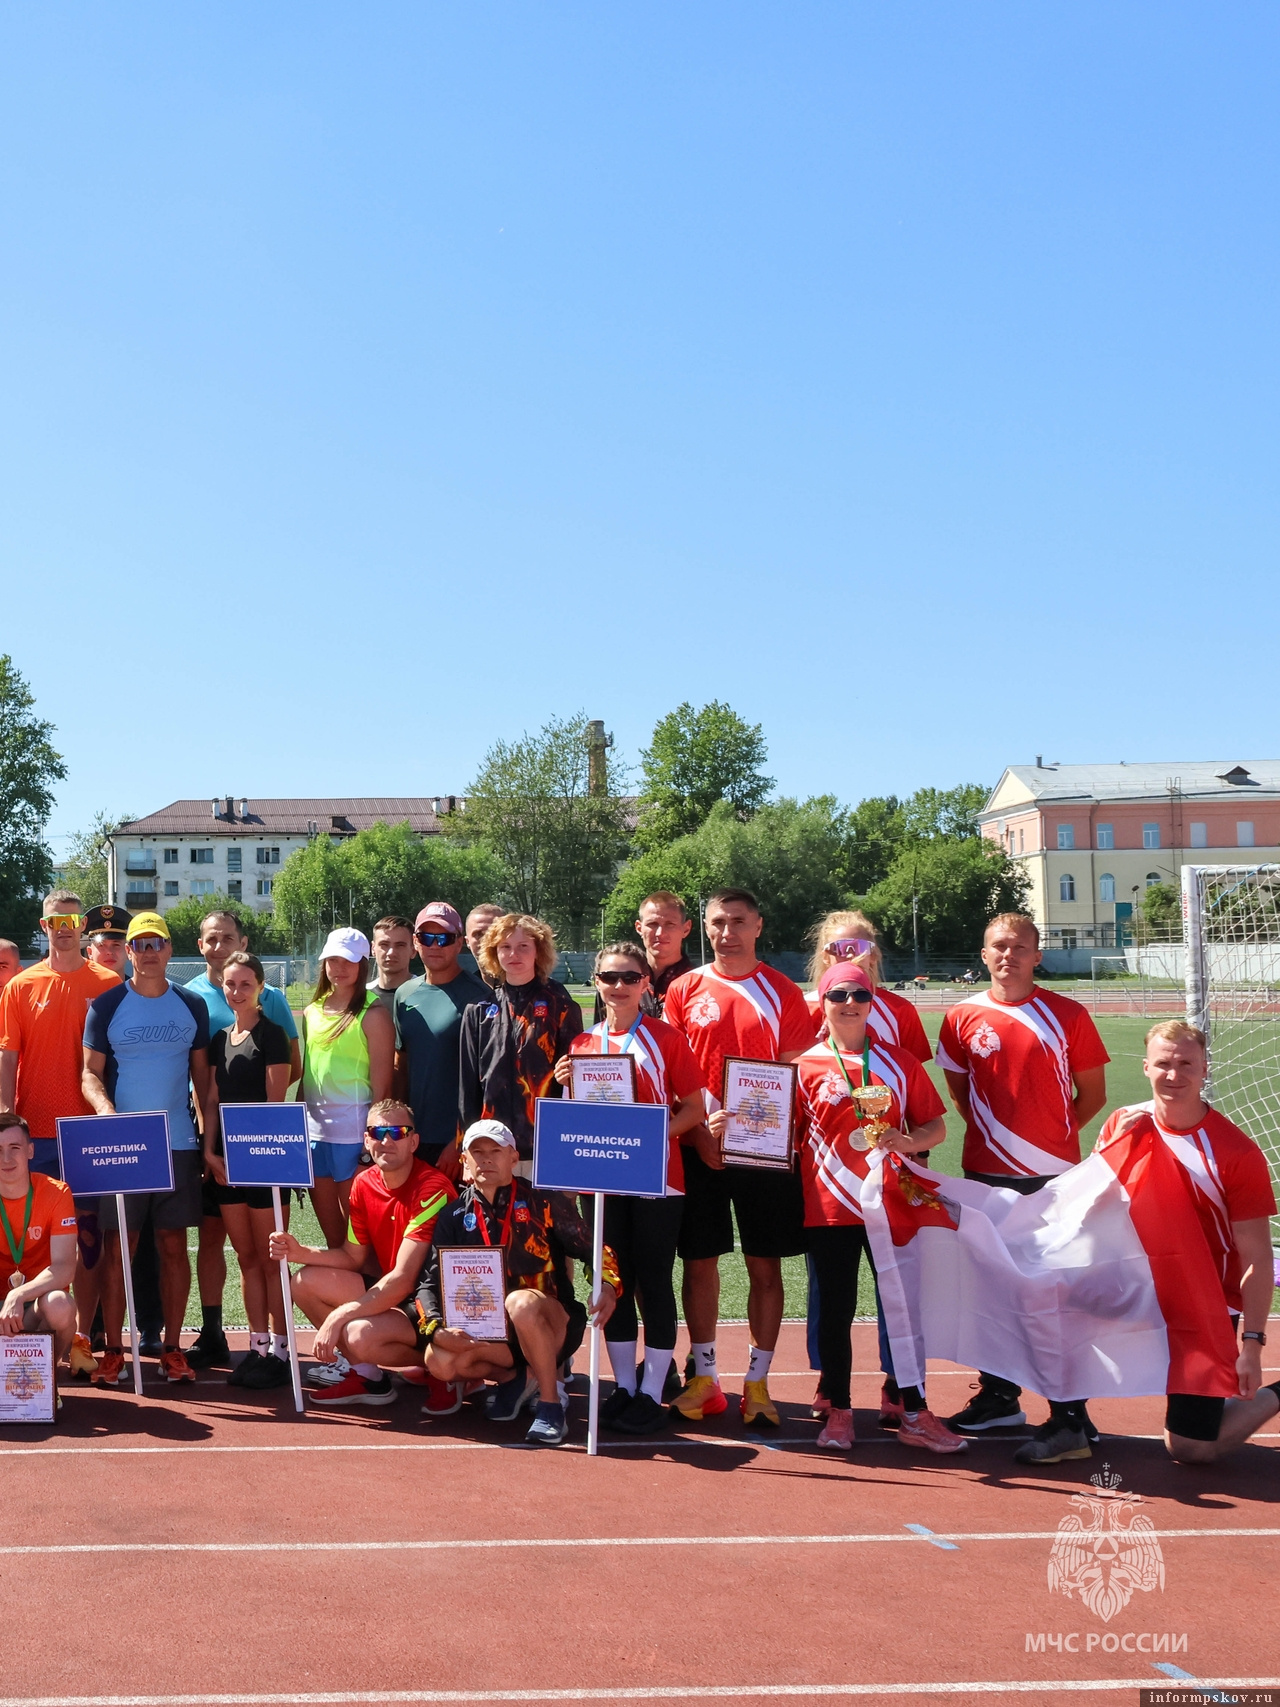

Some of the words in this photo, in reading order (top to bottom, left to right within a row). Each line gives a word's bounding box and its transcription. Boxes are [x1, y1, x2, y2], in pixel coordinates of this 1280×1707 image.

[582, 1072, 623, 1082] ГРАМОТА
[737, 1077, 783, 1091] ГРАМОТА
[227, 1134, 305, 1144] КАЛИНИНГРАДСКАЯ
[560, 1133, 641, 1147] МУРМАНСКАЯ
[81, 1143, 147, 1155] РЕСПУБЛИКА
[249, 1147, 287, 1156] ОБЛАСТЬ
[573, 1148, 630, 1160] ОБЛАСТЬ
[92, 1155, 139, 1166] КАРЕЛИЯ
[452, 1265, 494, 1275] ГРАМОТА
[4, 1348, 45, 1358] ГРАМОТА
